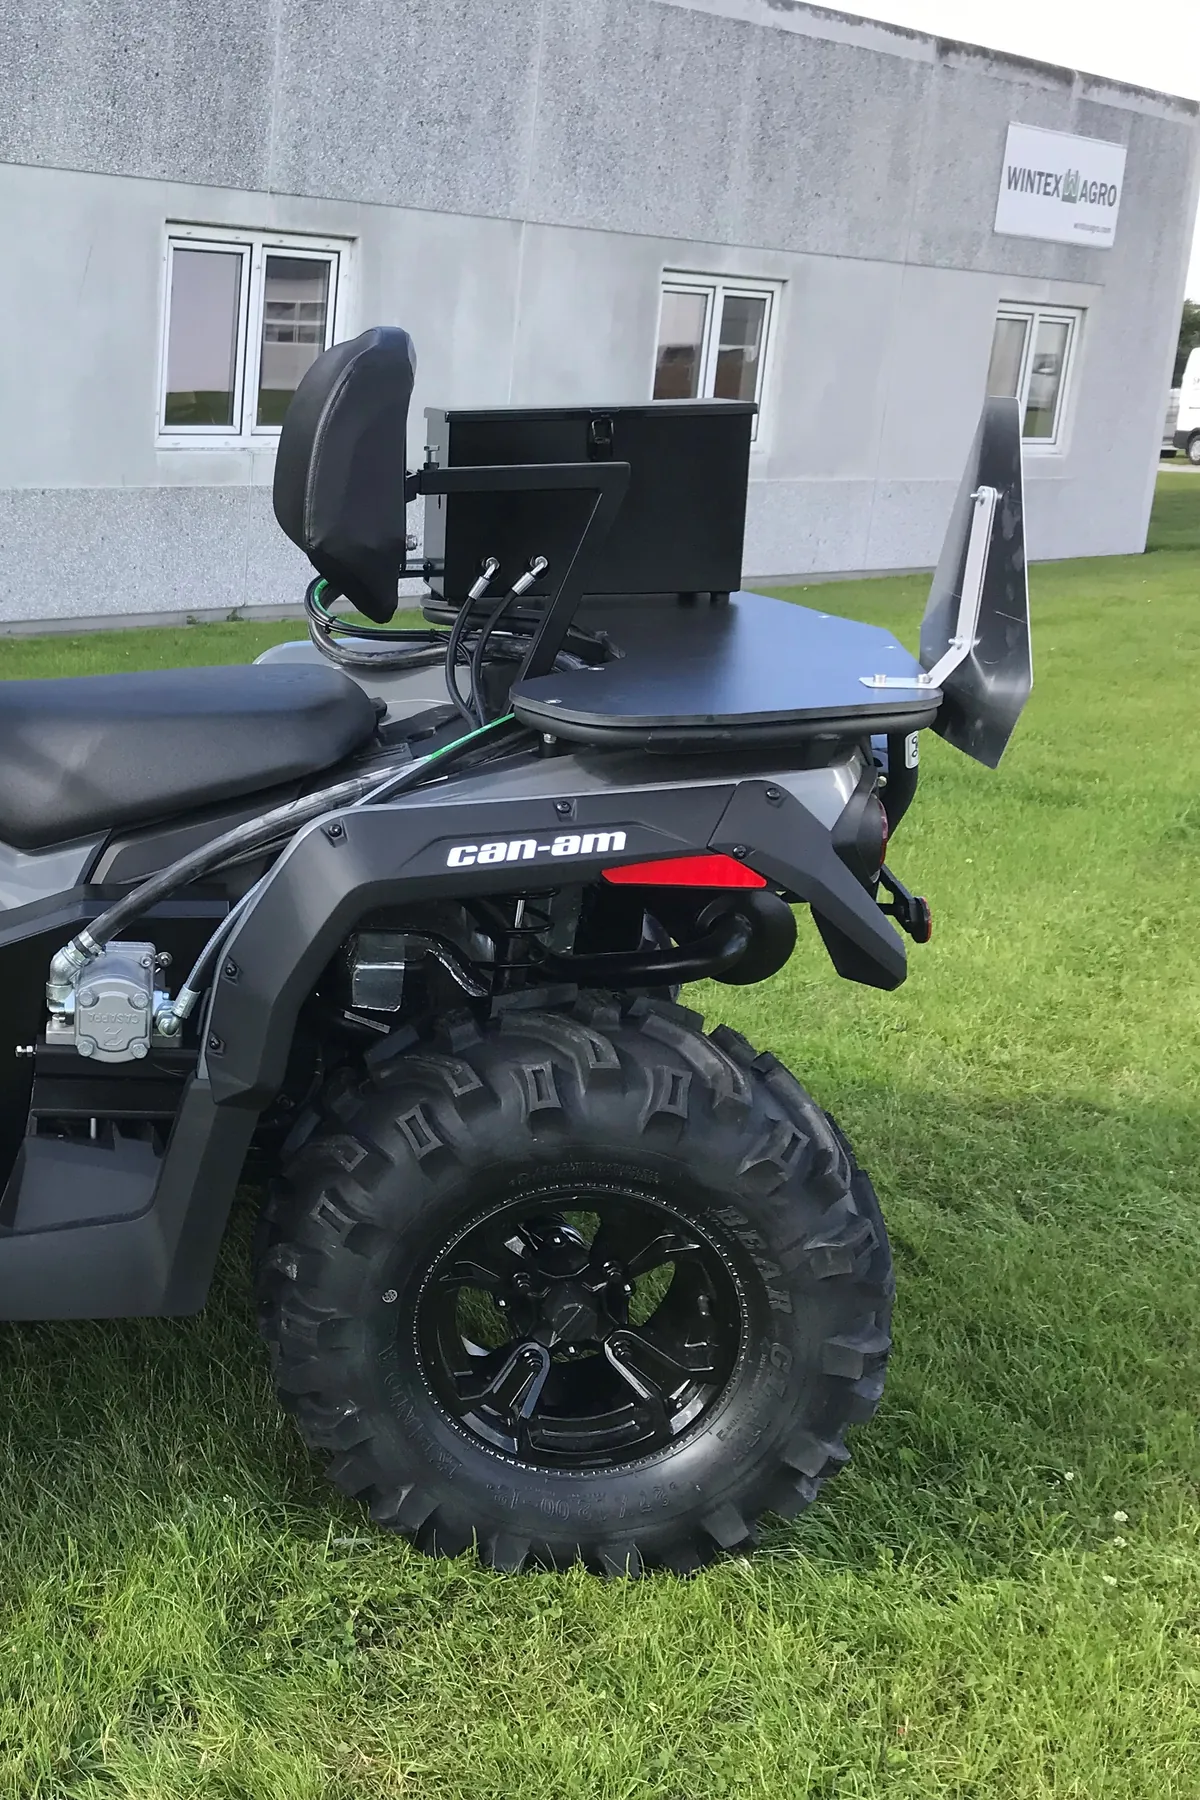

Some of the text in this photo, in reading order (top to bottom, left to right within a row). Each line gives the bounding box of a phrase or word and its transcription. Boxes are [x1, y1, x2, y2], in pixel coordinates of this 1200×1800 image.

[1007, 165, 1118, 207] WINTEX AGRO
[446, 831, 627, 868] can-am
[87, 1011, 140, 1025] CASAPPA
[715, 1205, 793, 1314] BEAR
